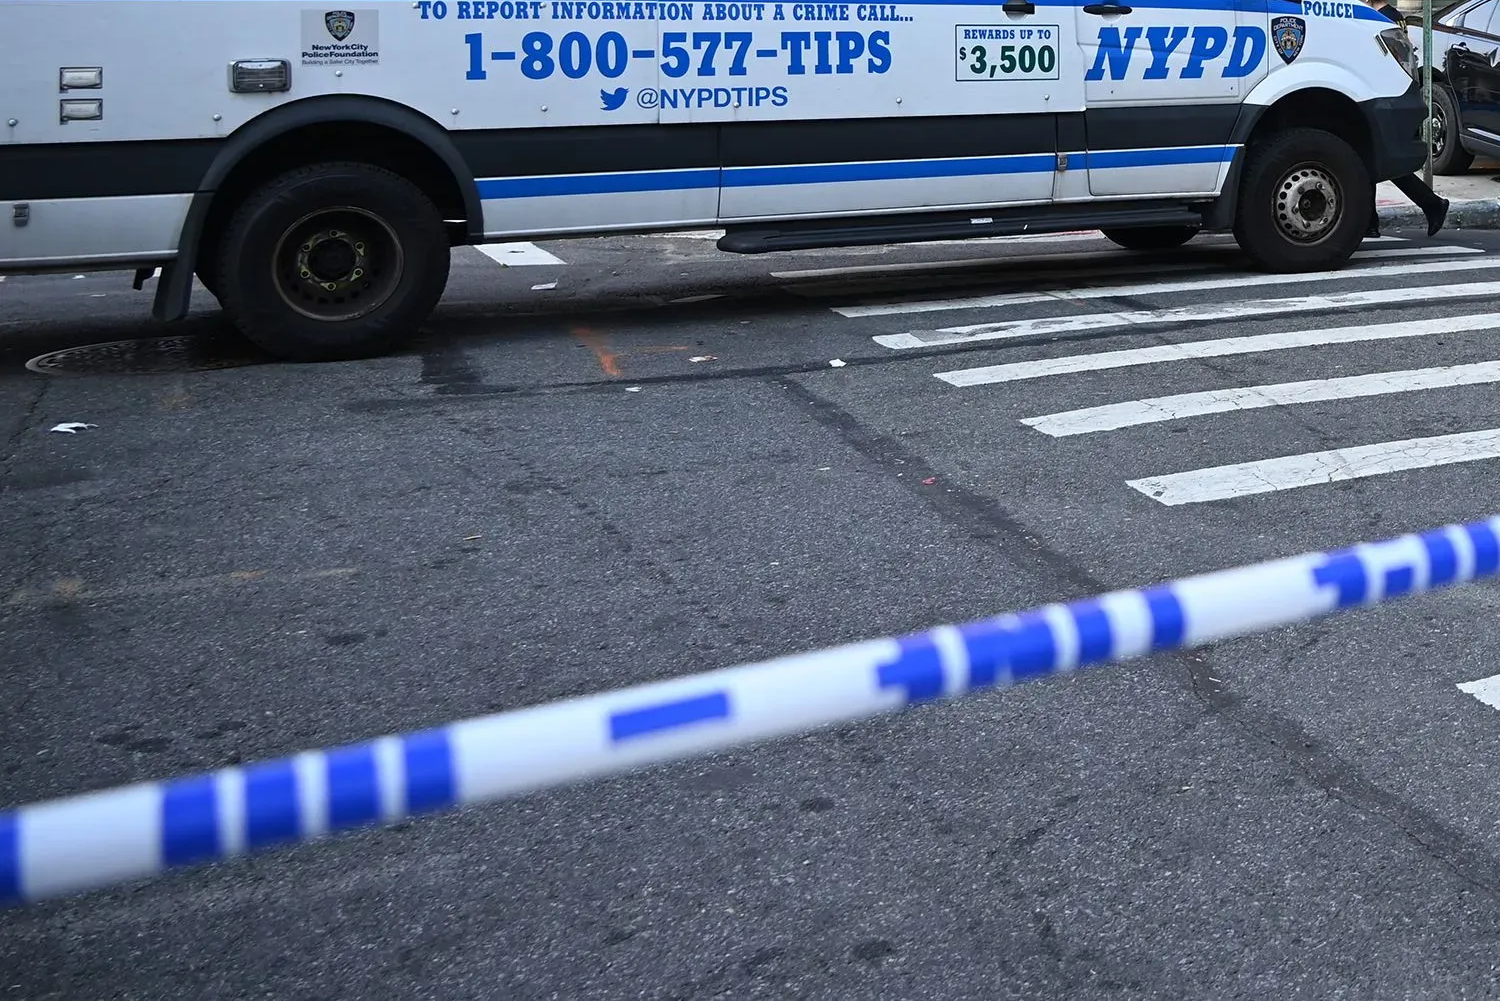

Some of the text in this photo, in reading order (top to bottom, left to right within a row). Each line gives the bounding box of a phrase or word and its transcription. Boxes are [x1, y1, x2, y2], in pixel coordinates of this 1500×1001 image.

[418, 1, 913, 21] TO REPORT INFORMATION ABOUT A CRIME CALL...
[1303, 1, 1352, 18] POLICE
[963, 29, 1051, 39] REWARDS UP TO
[465, 30, 892, 80] 1-800-577-TIPS
[960, 45, 1055, 78] $3,500
[1084, 25, 1266, 80] NYPD
[636, 86, 788, 109] @NYPDTIPS
